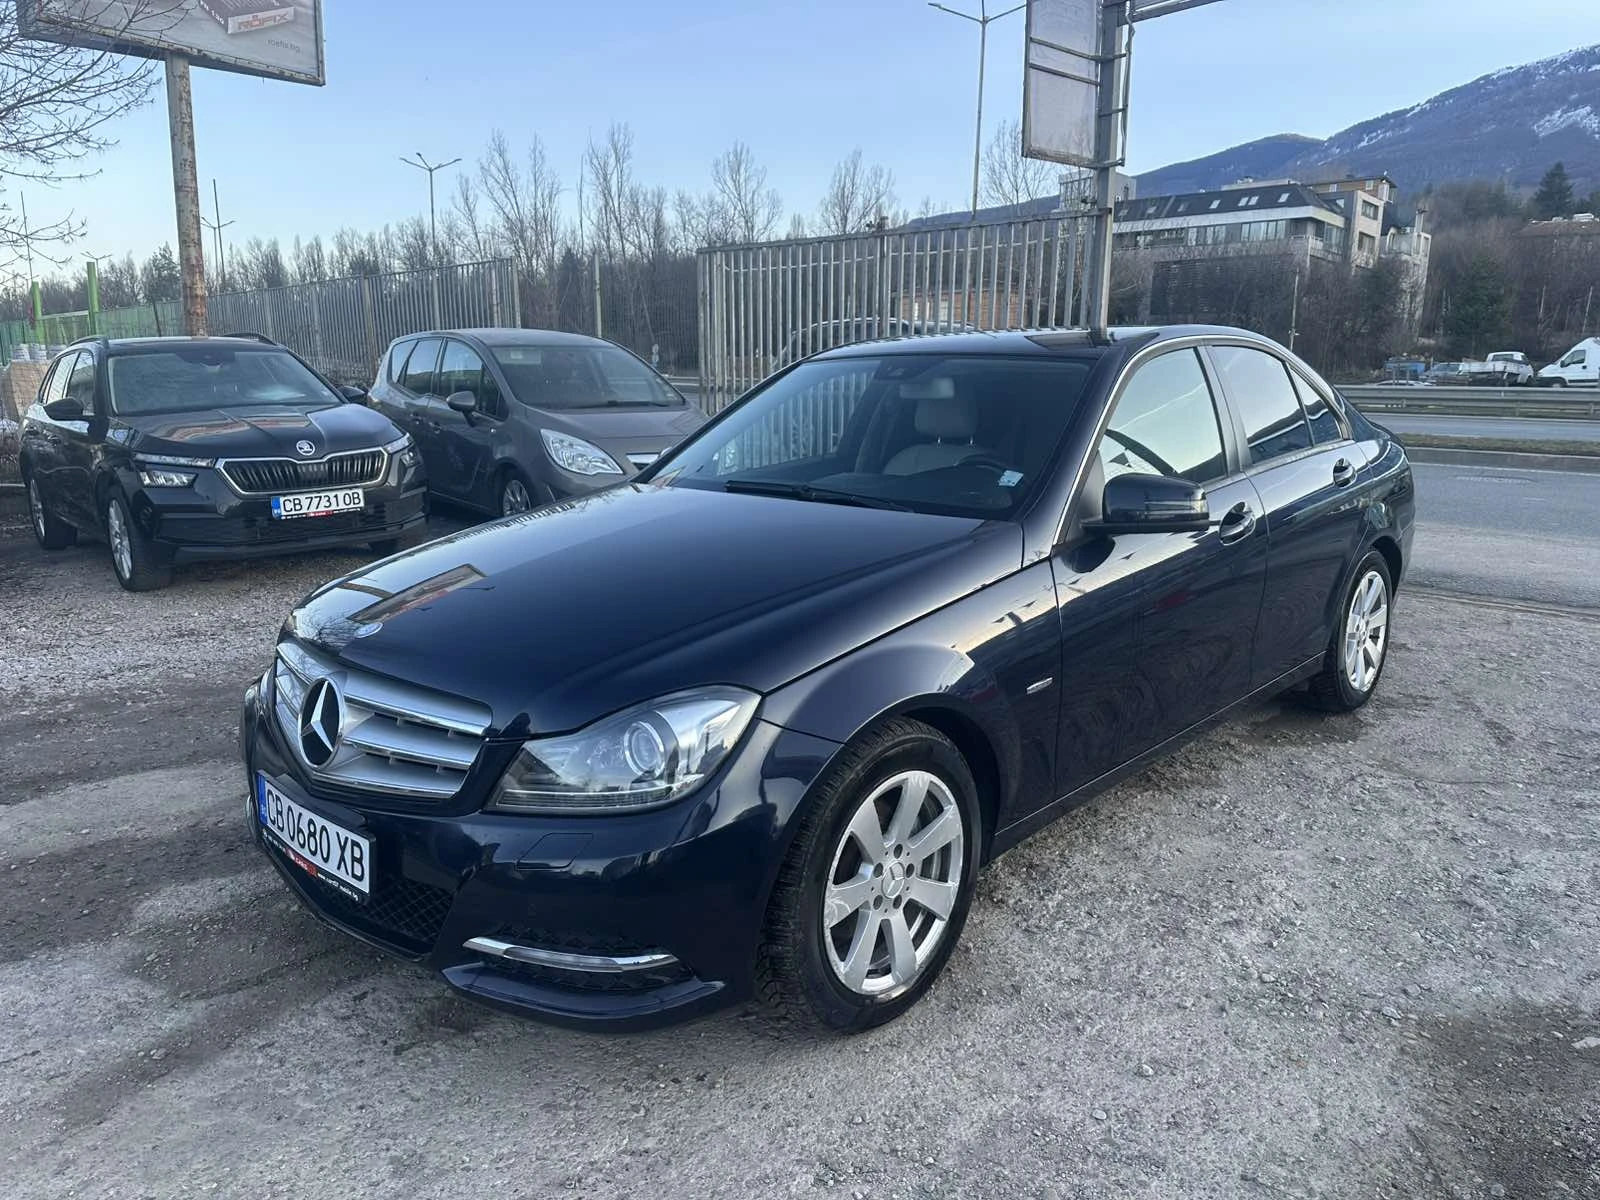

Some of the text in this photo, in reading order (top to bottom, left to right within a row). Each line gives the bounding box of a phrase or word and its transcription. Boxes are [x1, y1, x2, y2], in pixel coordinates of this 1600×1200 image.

[282, 497, 303, 513] CB
[304, 493, 340, 511] 7731
[266, 789, 285, 833] CB
[286, 804, 331, 864] 0680
[335, 831, 365, 882] XB
